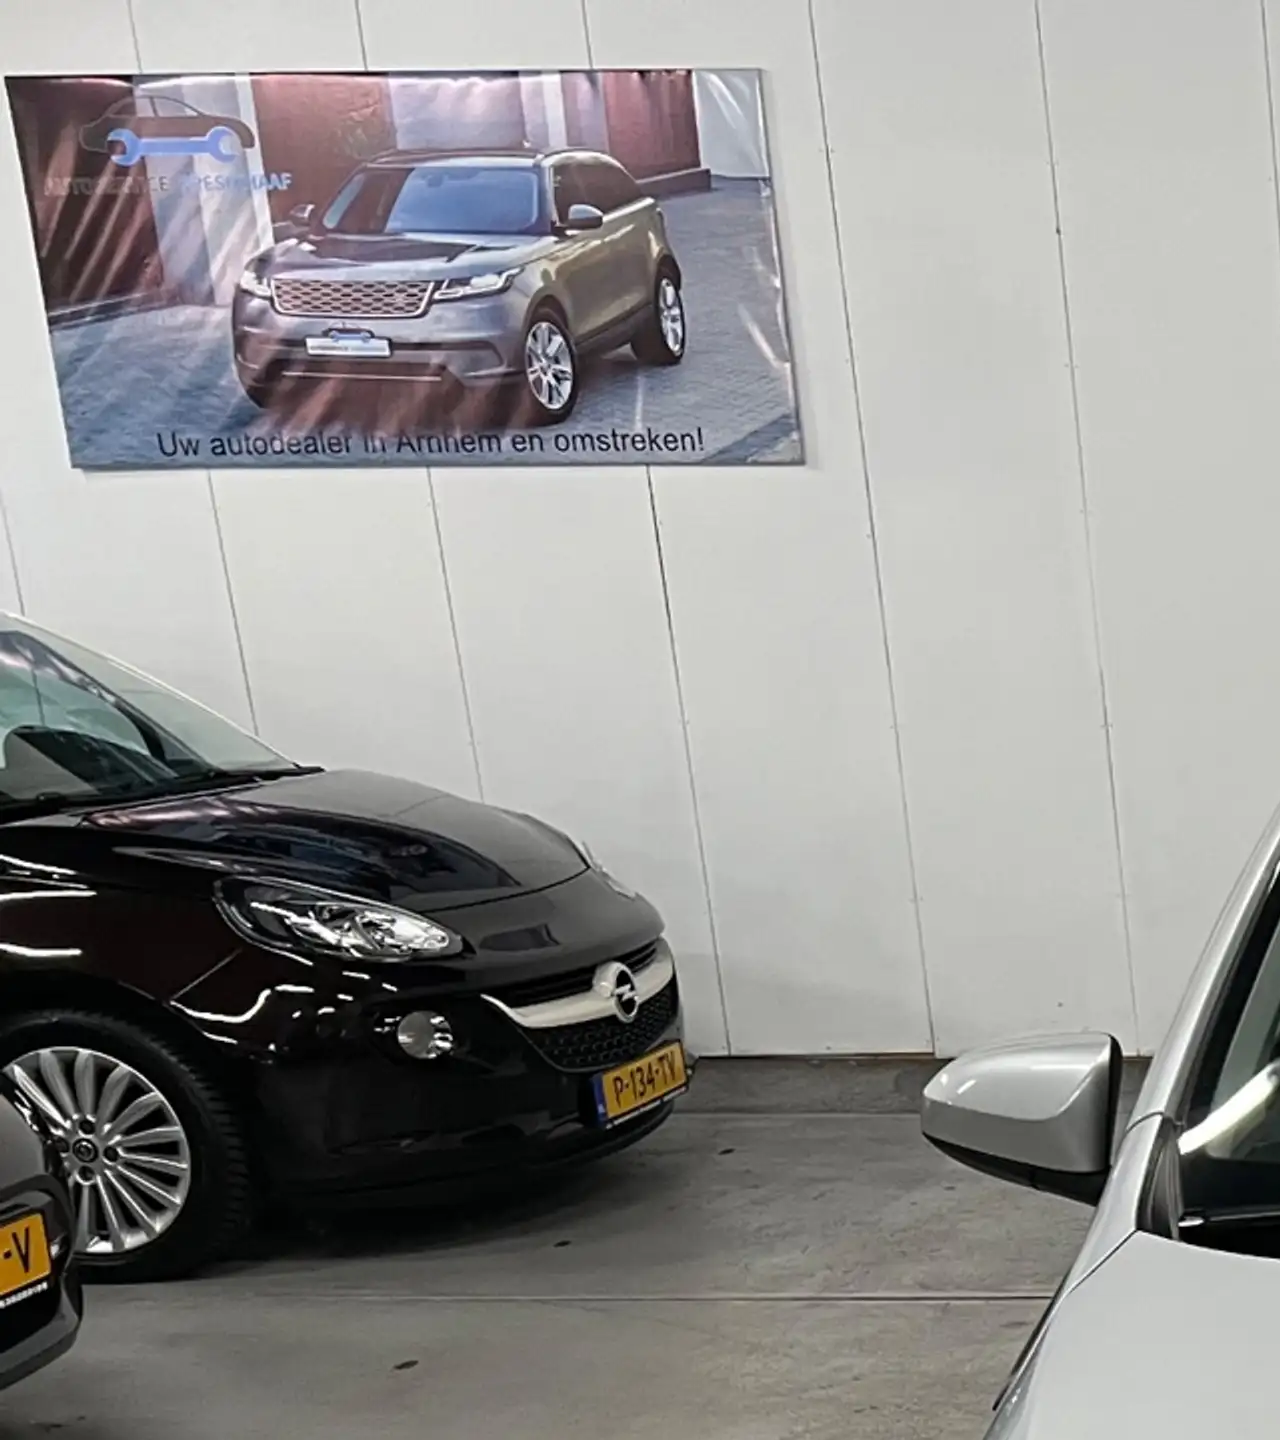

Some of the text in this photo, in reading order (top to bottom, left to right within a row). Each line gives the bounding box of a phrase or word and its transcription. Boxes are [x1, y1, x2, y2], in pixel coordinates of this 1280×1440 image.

[156, 431, 200, 457] Uw
[210, 429, 352, 456] autodealer
[396, 429, 501, 454] Arnhem
[511, 433, 544, 453] en
[554, 427, 704, 453] omstreken!
[612, 1050, 677, 1109] P-134-TV
